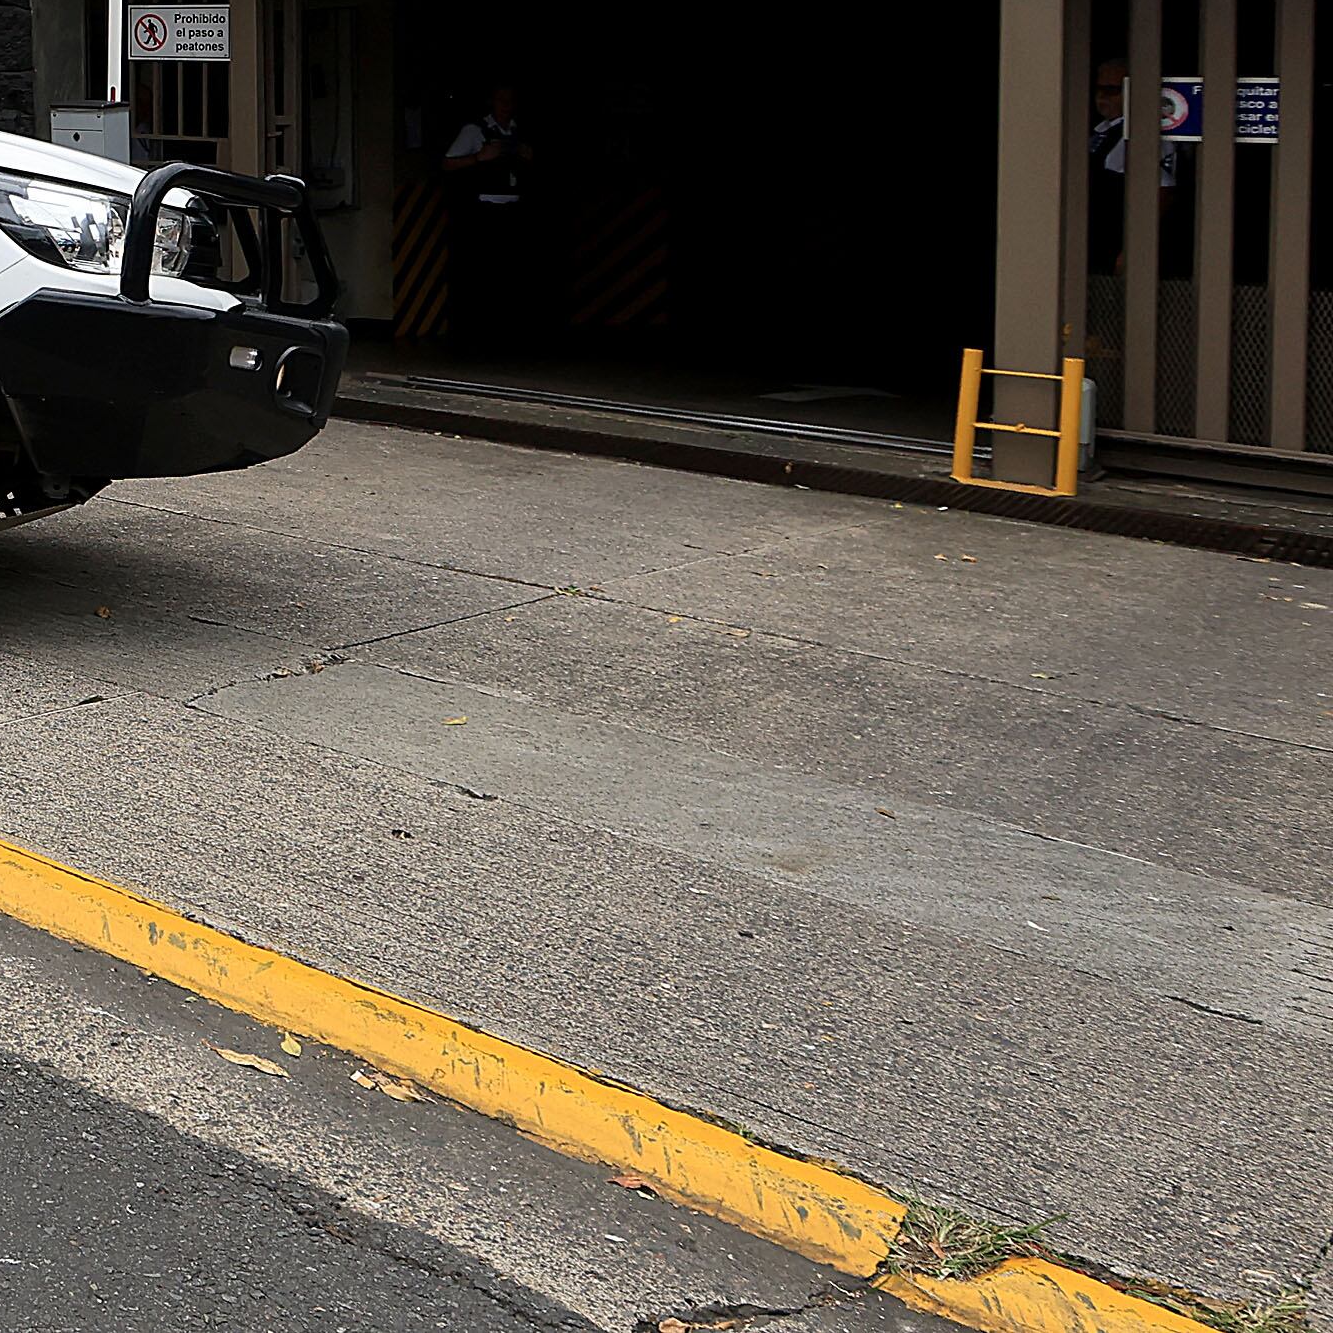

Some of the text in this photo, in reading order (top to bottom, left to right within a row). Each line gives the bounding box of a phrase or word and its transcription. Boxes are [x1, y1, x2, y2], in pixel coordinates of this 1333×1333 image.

[174, 13, 226, 24] Prohibido
[176, 28, 186, 37] el
[189, 29, 214, 39] paso
[175, 41, 224, 53] peatones
[1237, 87, 1279, 97] quitar
[1238, 100, 1265, 108] sco
[1238, 125, 1278, 134] ciclet
